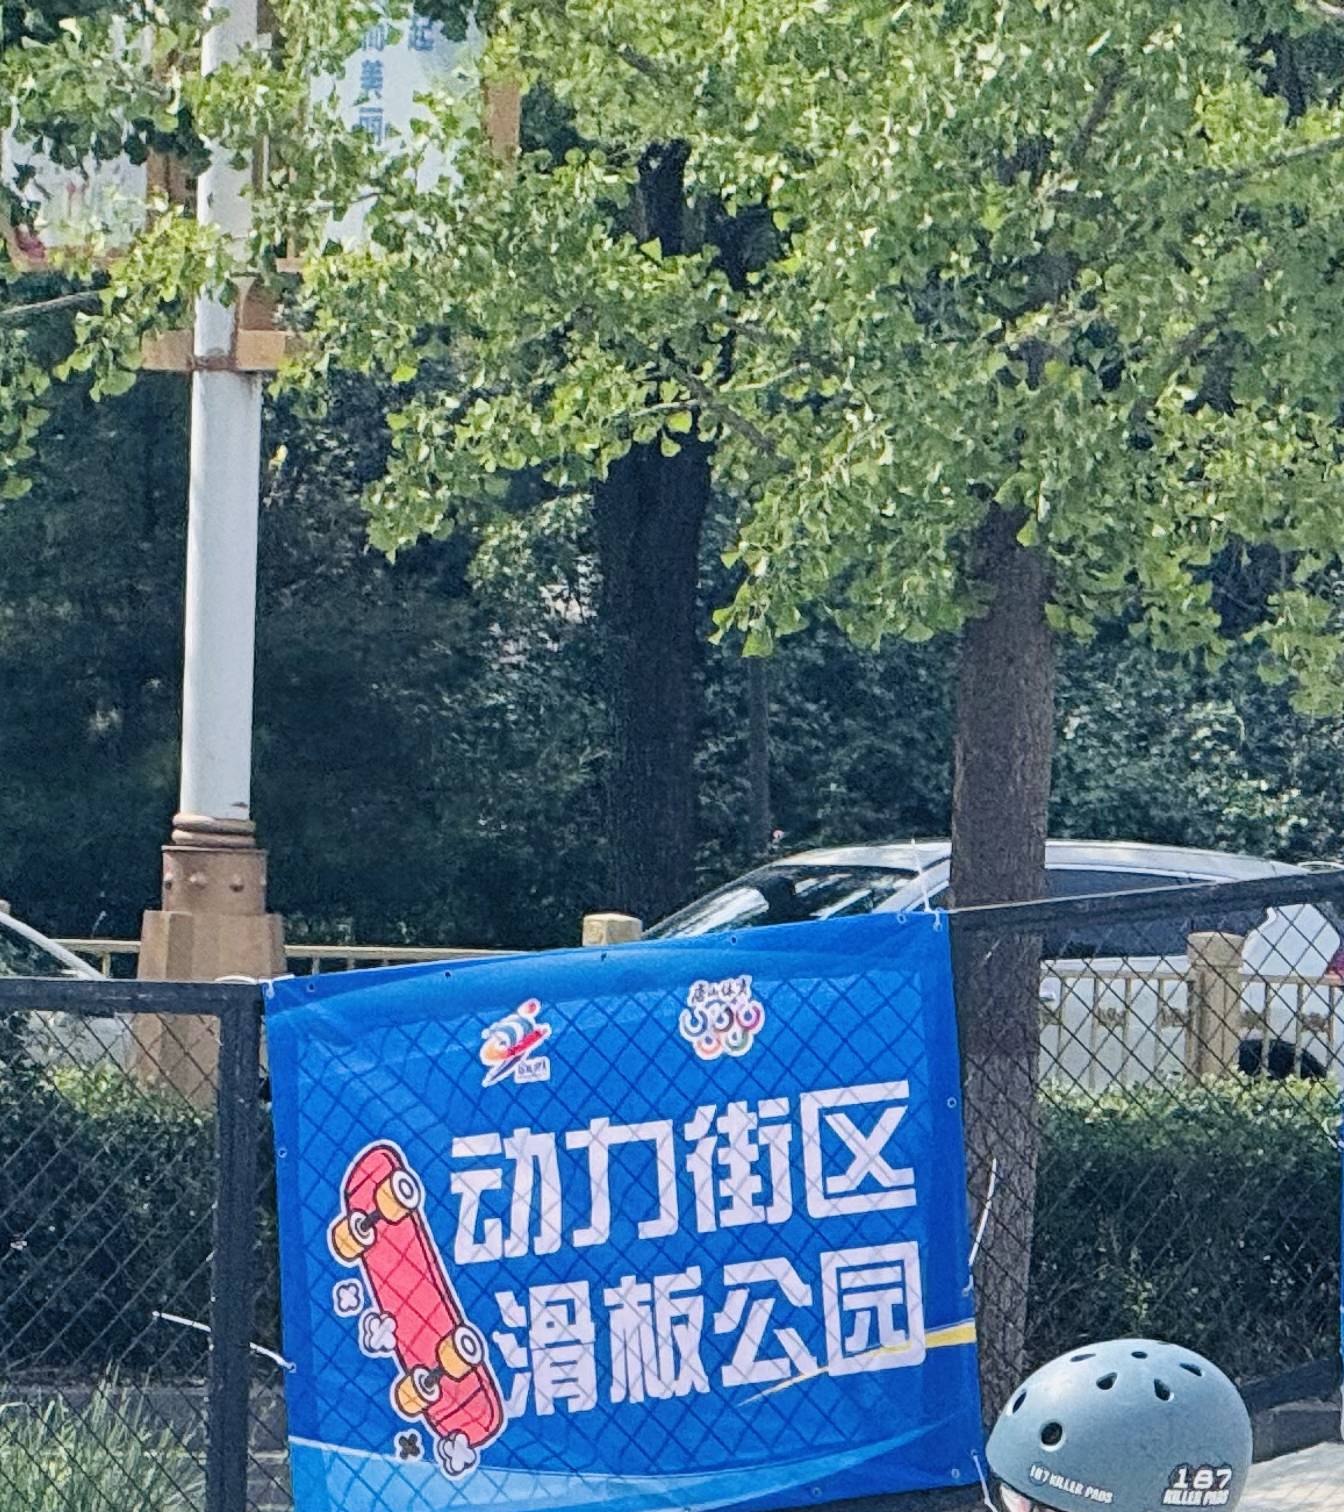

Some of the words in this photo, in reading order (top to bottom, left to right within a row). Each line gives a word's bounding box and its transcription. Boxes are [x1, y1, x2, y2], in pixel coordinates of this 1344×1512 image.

[451, 1080, 917, 1265] 动力街区
[492, 1241, 927, 1419] 滑板公园
[1030, 1464, 1050, 1482] 187
[1049, 1474, 1083, 1495] KILLER
[1172, 1467, 1232, 1489] 187
